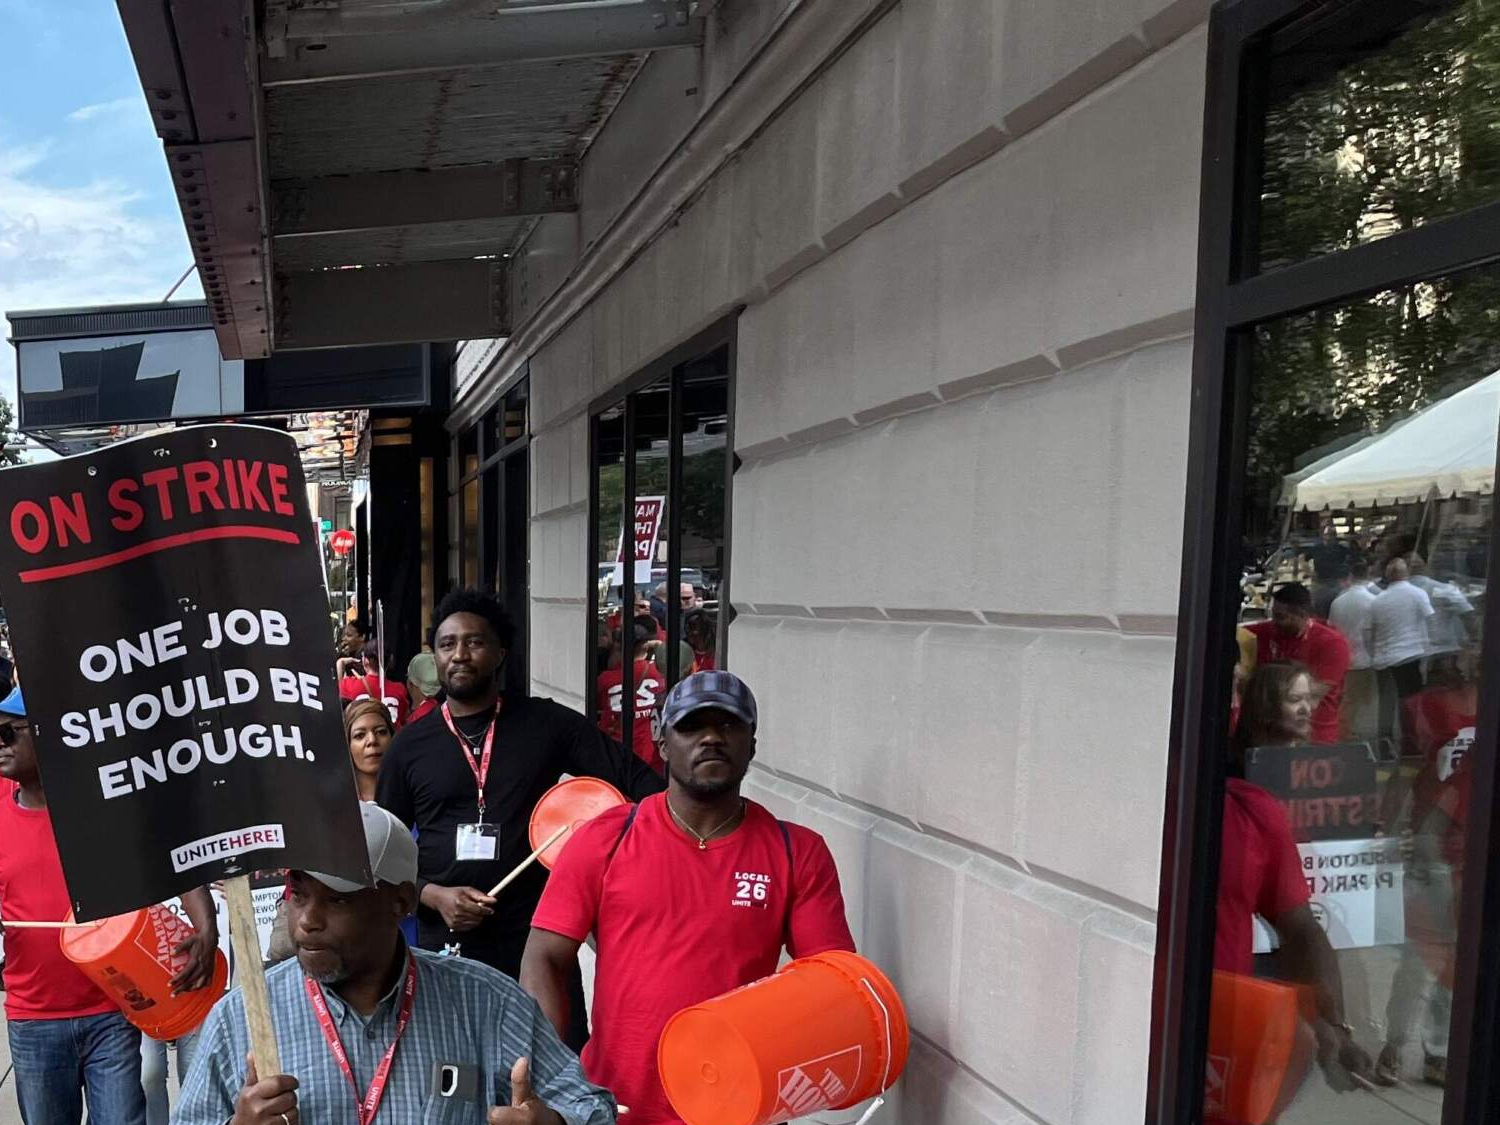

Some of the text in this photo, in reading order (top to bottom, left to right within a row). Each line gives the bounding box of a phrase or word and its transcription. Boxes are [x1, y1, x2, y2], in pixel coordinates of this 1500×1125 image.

[10, 458, 295, 554] ON STRIKE
[79, 608, 290, 682] ONE JOB
[59, 667, 324, 747] SHOULD BE
[97, 724, 315, 800] ENOUGH.
[176, 829, 280, 866] UNITEHERE!
[735, 871, 771, 883] LOCAL
[736, 880, 767, 900] 26
[255, 891, 282, 902] MPTO
[365, 1086, 380, 1111] UNITE
